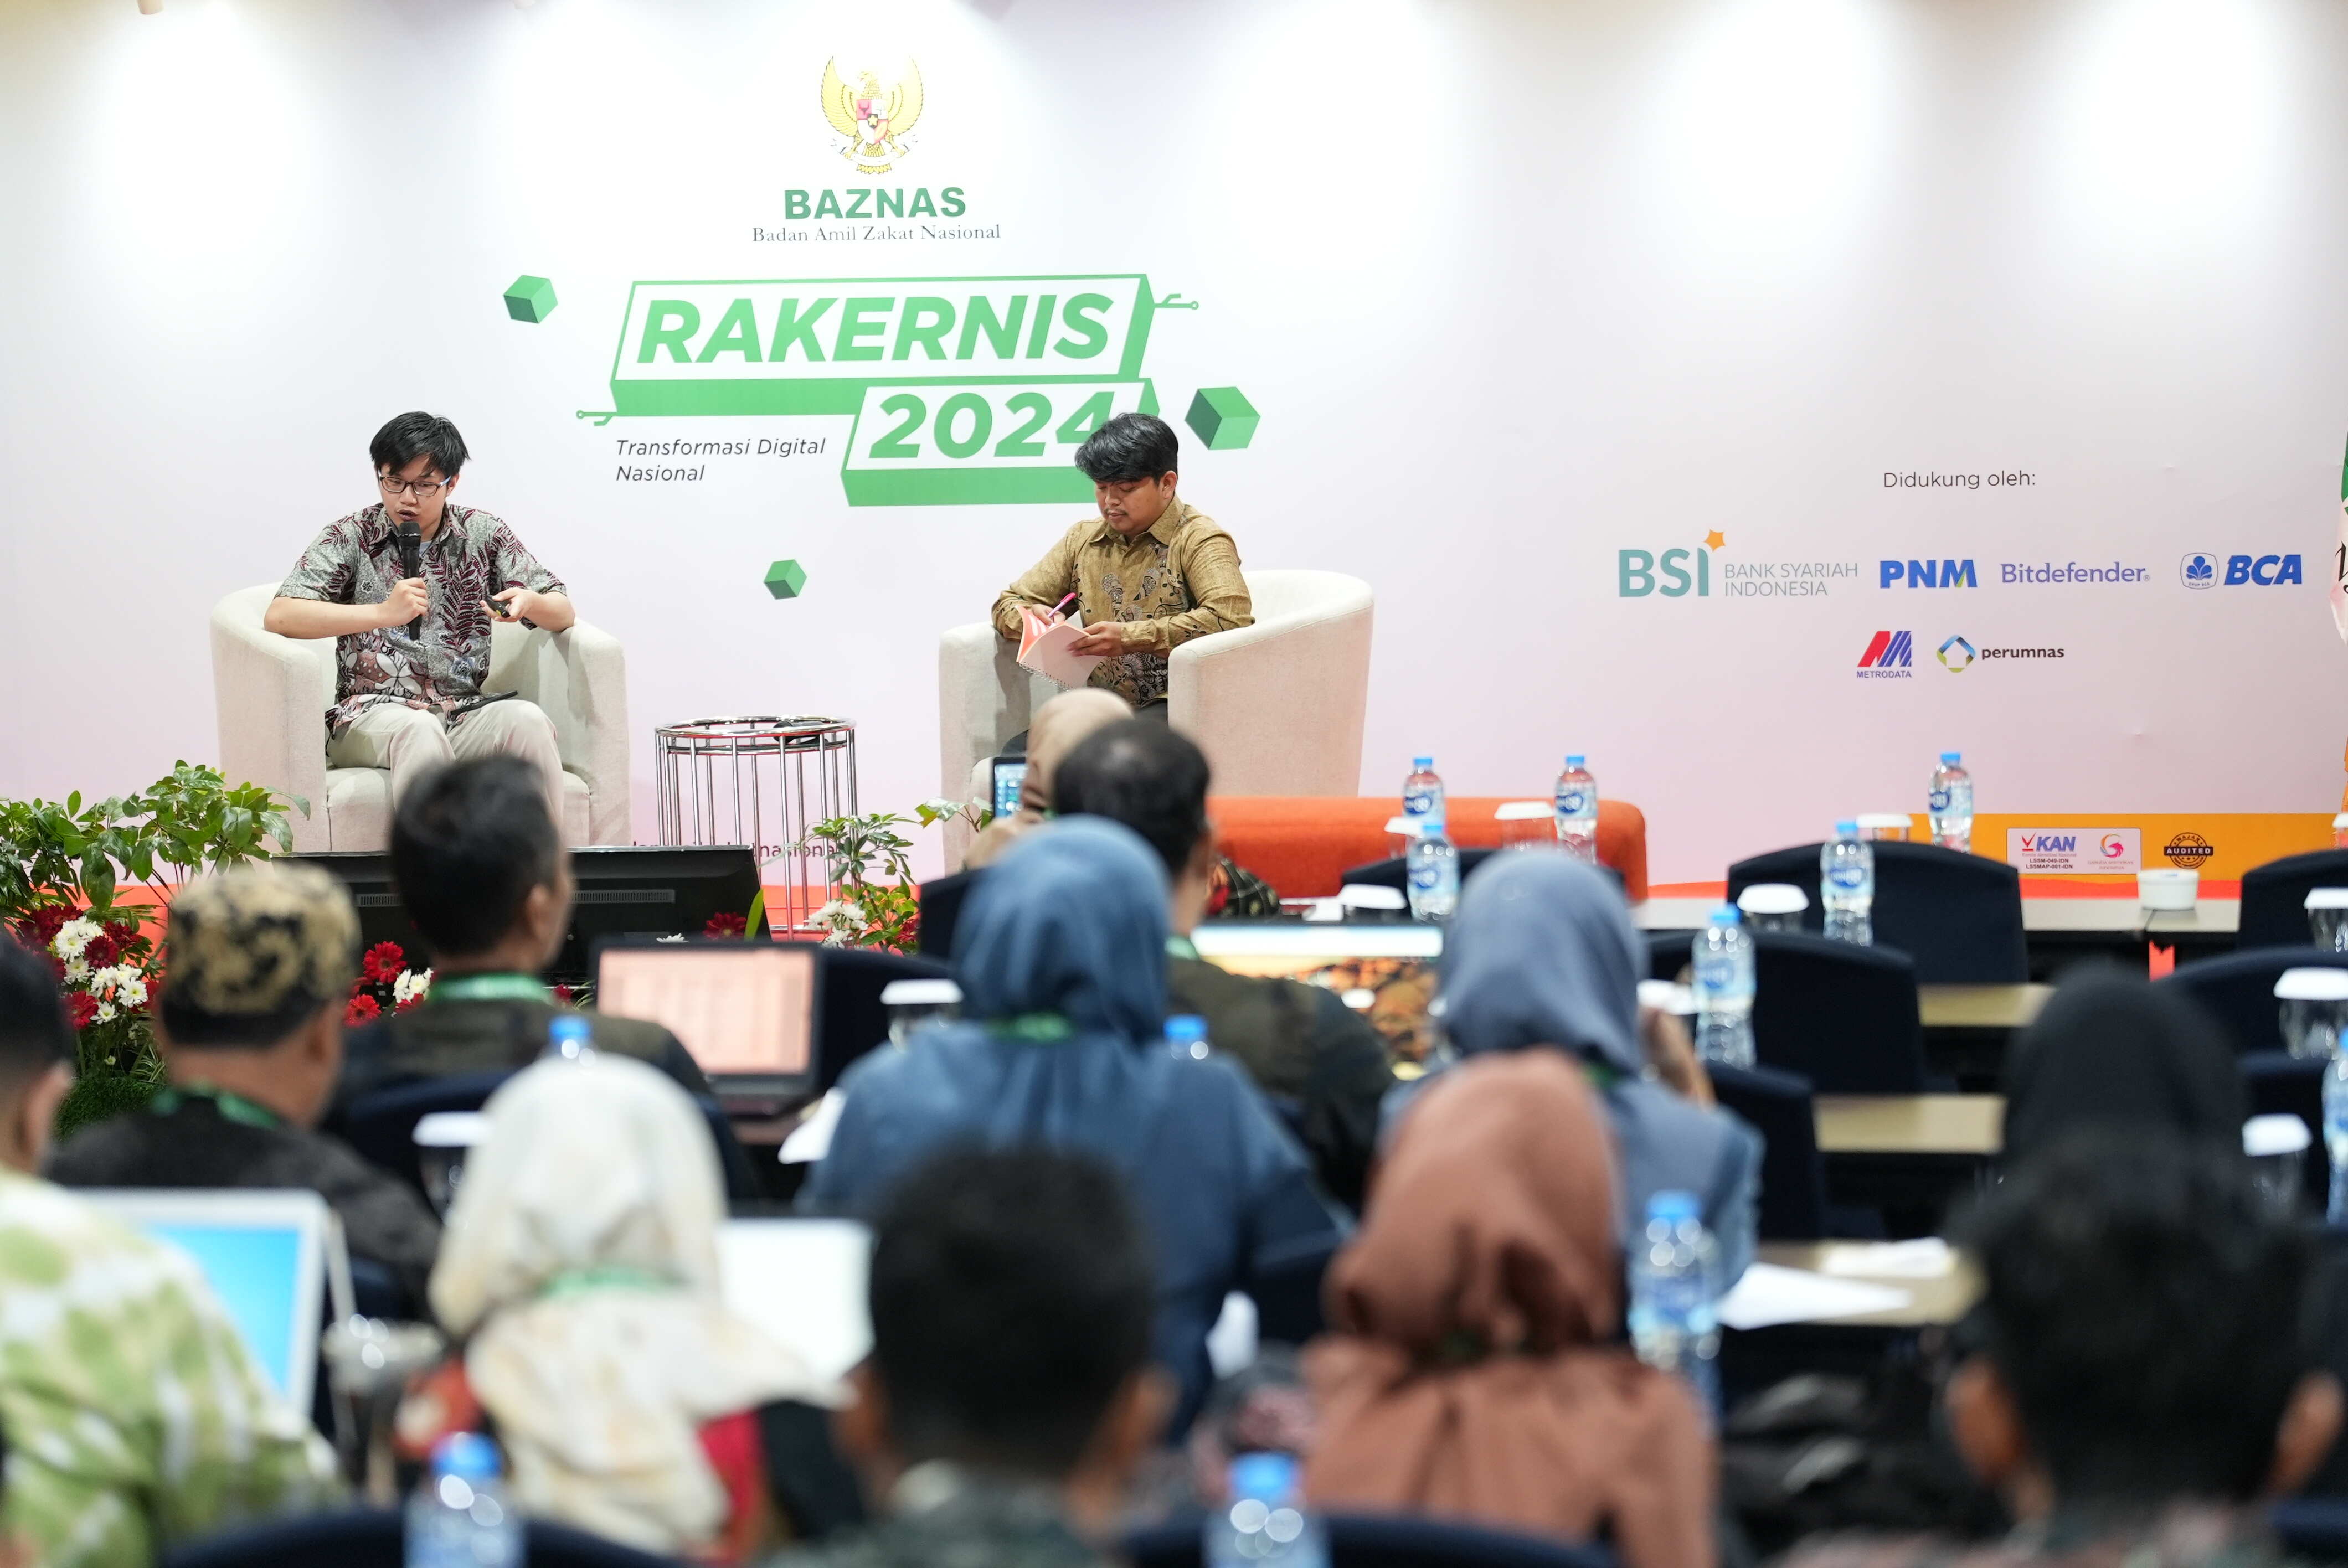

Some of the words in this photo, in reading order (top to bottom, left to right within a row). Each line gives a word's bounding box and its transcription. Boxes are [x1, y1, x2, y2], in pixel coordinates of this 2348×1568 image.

[784, 187, 966, 220] BAZNAS
[753, 227, 807, 242] Badan
[815, 226, 856, 241] Amil
[863, 226, 913, 240] Zakat
[920, 224, 1001, 240] Nasional
[637, 292, 1114, 363] RAKERNIS
[869, 392, 1115, 459] 2024
[616, 438, 751, 456] Transformasi
[757, 437, 826, 458] Digital
[616, 464, 705, 482] Nasional
[1884, 471, 1980, 490] Didukung
[1987, 469, 2036, 487] oleh:
[1619, 548, 1709, 597] BSI
[1725, 564, 1777, 579] BANK
[1780, 562, 1858, 578] SYARIAH
[1879, 559, 1978, 589] PNM
[2223, 554, 2303, 586] BCA
[1725, 581, 1828, 597] INDONESIA
[1981, 648, 2064, 661] perumnas
[2036, 837, 2076, 852] KAN
